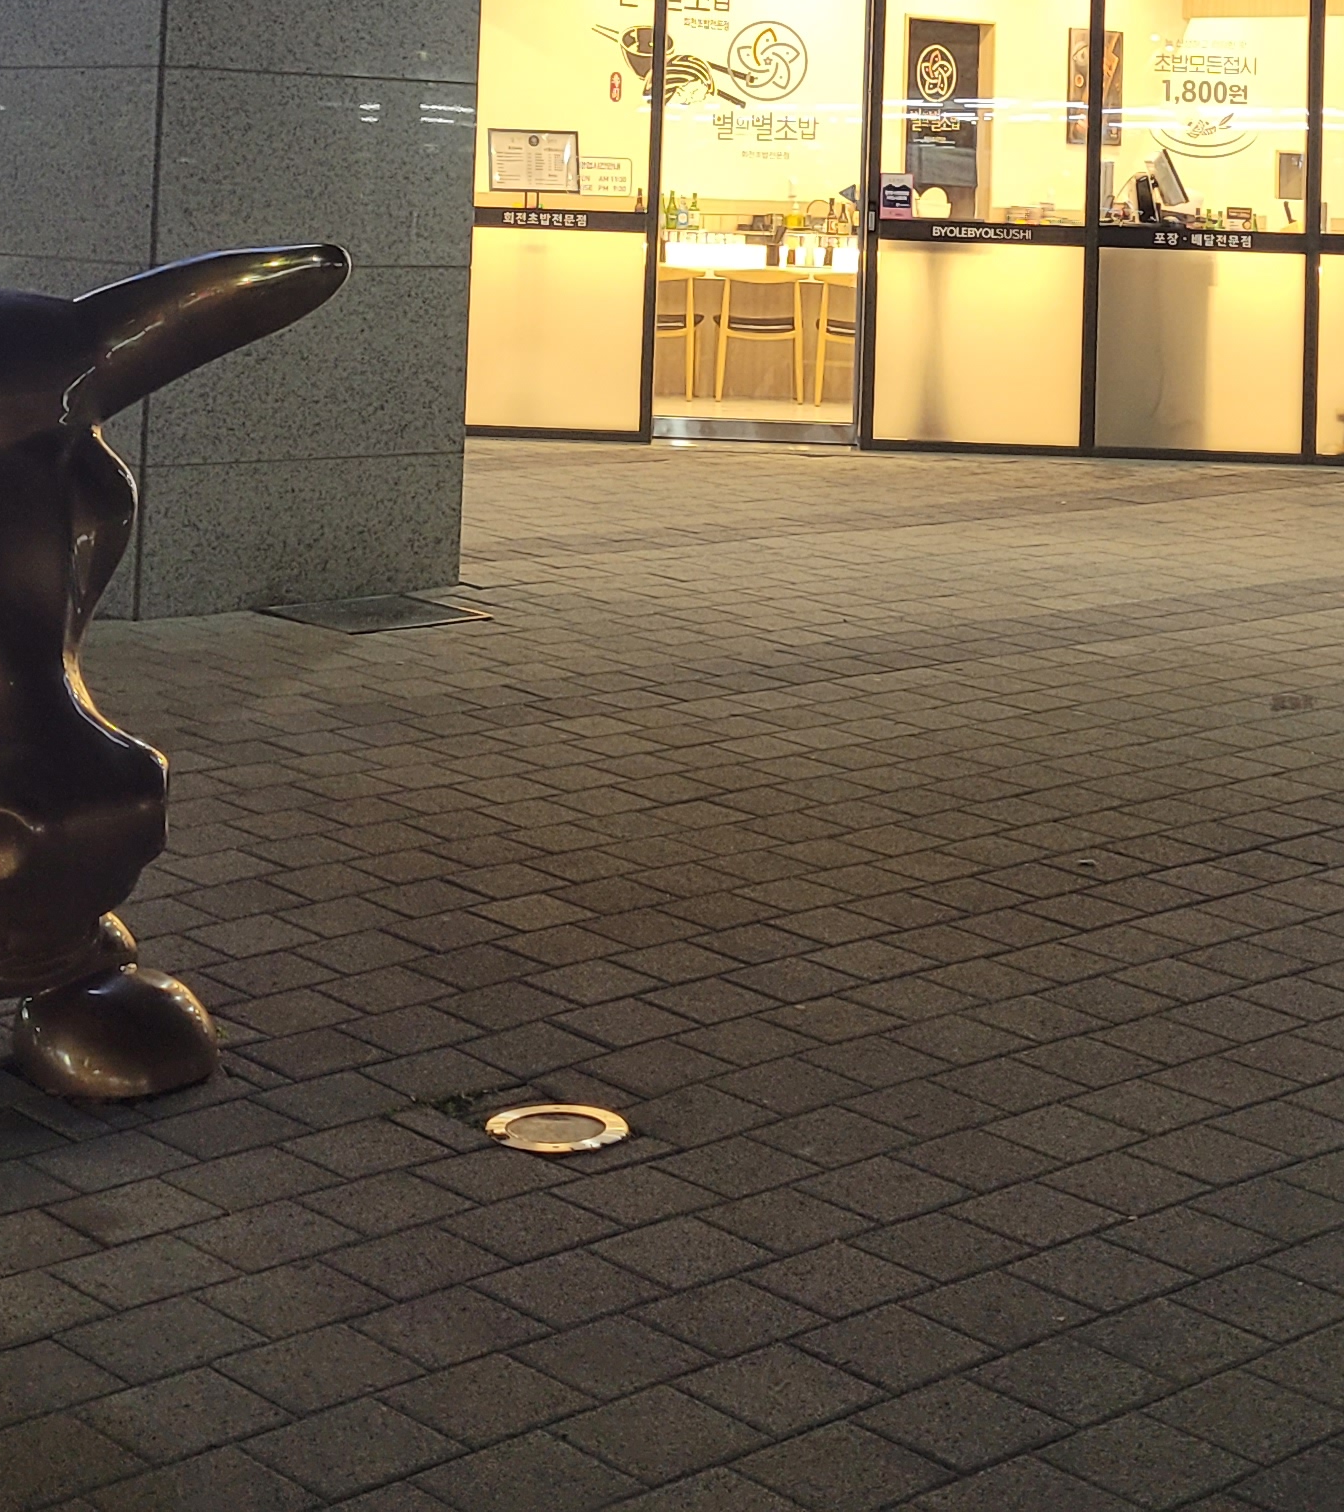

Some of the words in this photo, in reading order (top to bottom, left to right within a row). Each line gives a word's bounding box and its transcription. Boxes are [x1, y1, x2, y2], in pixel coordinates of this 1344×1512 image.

[1153, 53, 1258, 76] 초밥모든접시
[1161, 79, 1248, 105] 1,800원
[712, 110, 820, 142] 별의별초밥
[502, 211, 588, 227] 회전초밥전문점
[932, 225, 1032, 241] BYOLEBYOLSUSHI
[1153, 232, 1179, 246] 포장
[1191, 233, 1252, 249] 배달전문점
